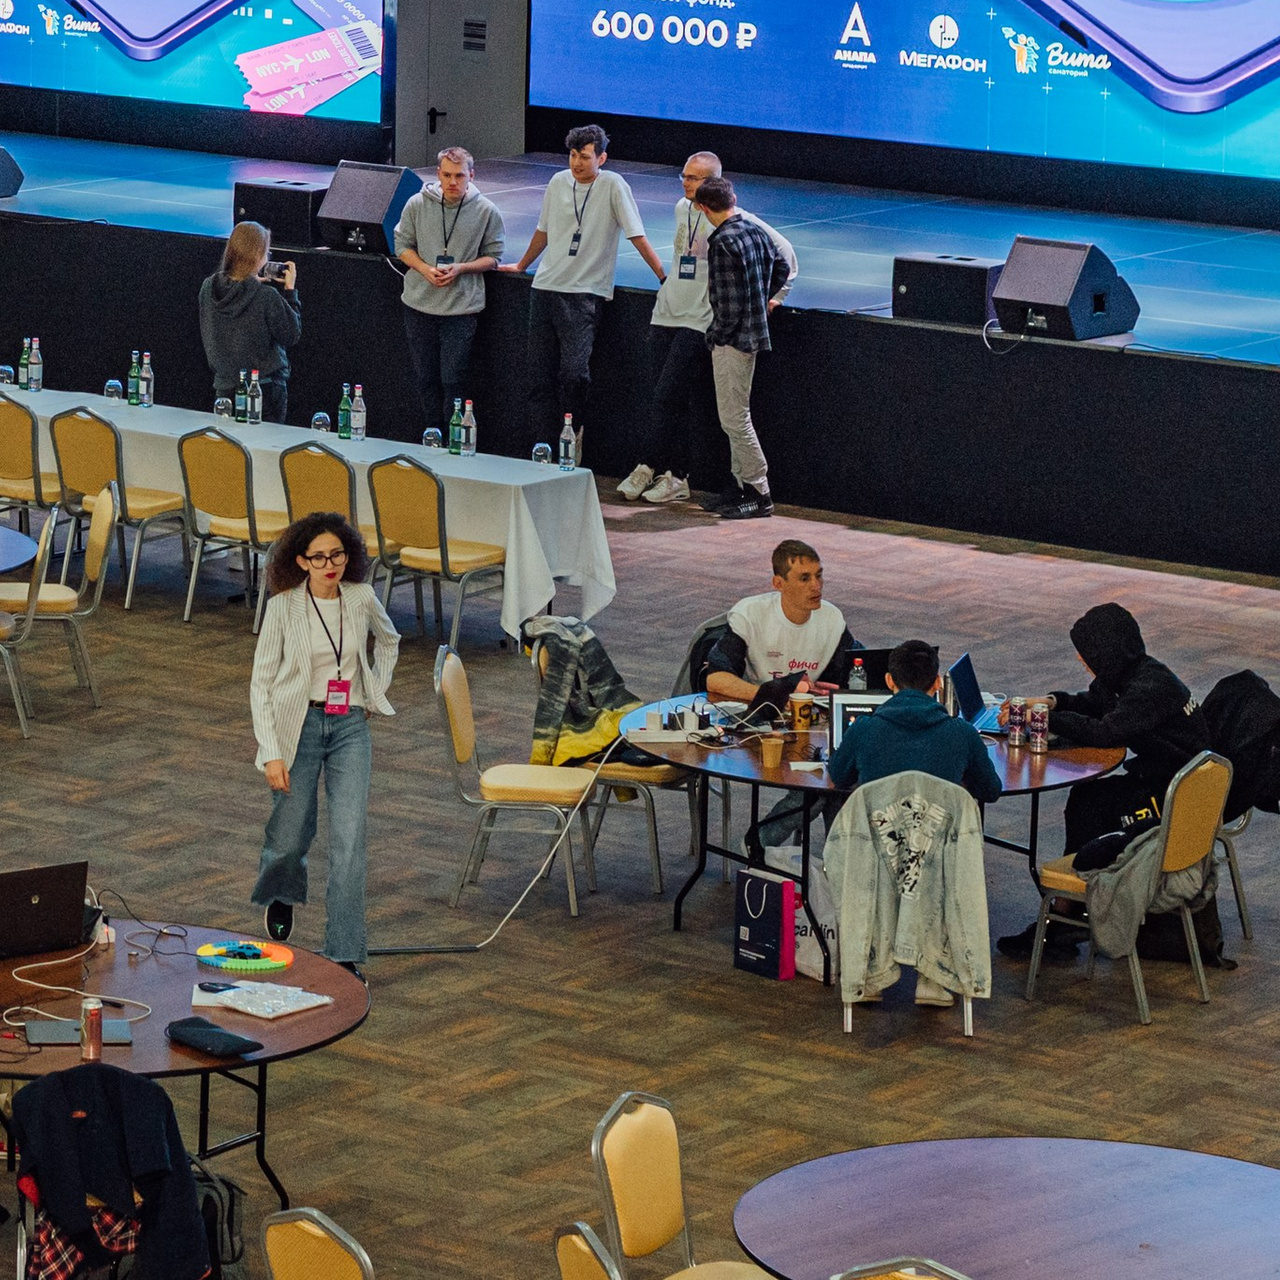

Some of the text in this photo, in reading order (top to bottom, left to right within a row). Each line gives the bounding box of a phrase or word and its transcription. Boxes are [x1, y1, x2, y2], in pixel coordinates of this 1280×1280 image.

[63, 15, 101, 33] Вита
[592, 10, 654, 42] 600
[662, 15, 728, 48] 000
[255, 62, 281, 78] NYC
[306, 48, 331, 64] LON
[834, 49, 876, 64] АНАПА
[1046, 43, 1112, 69] Вита
[264, 94, 289, 112] LON
[788, 659, 819, 671] фича
